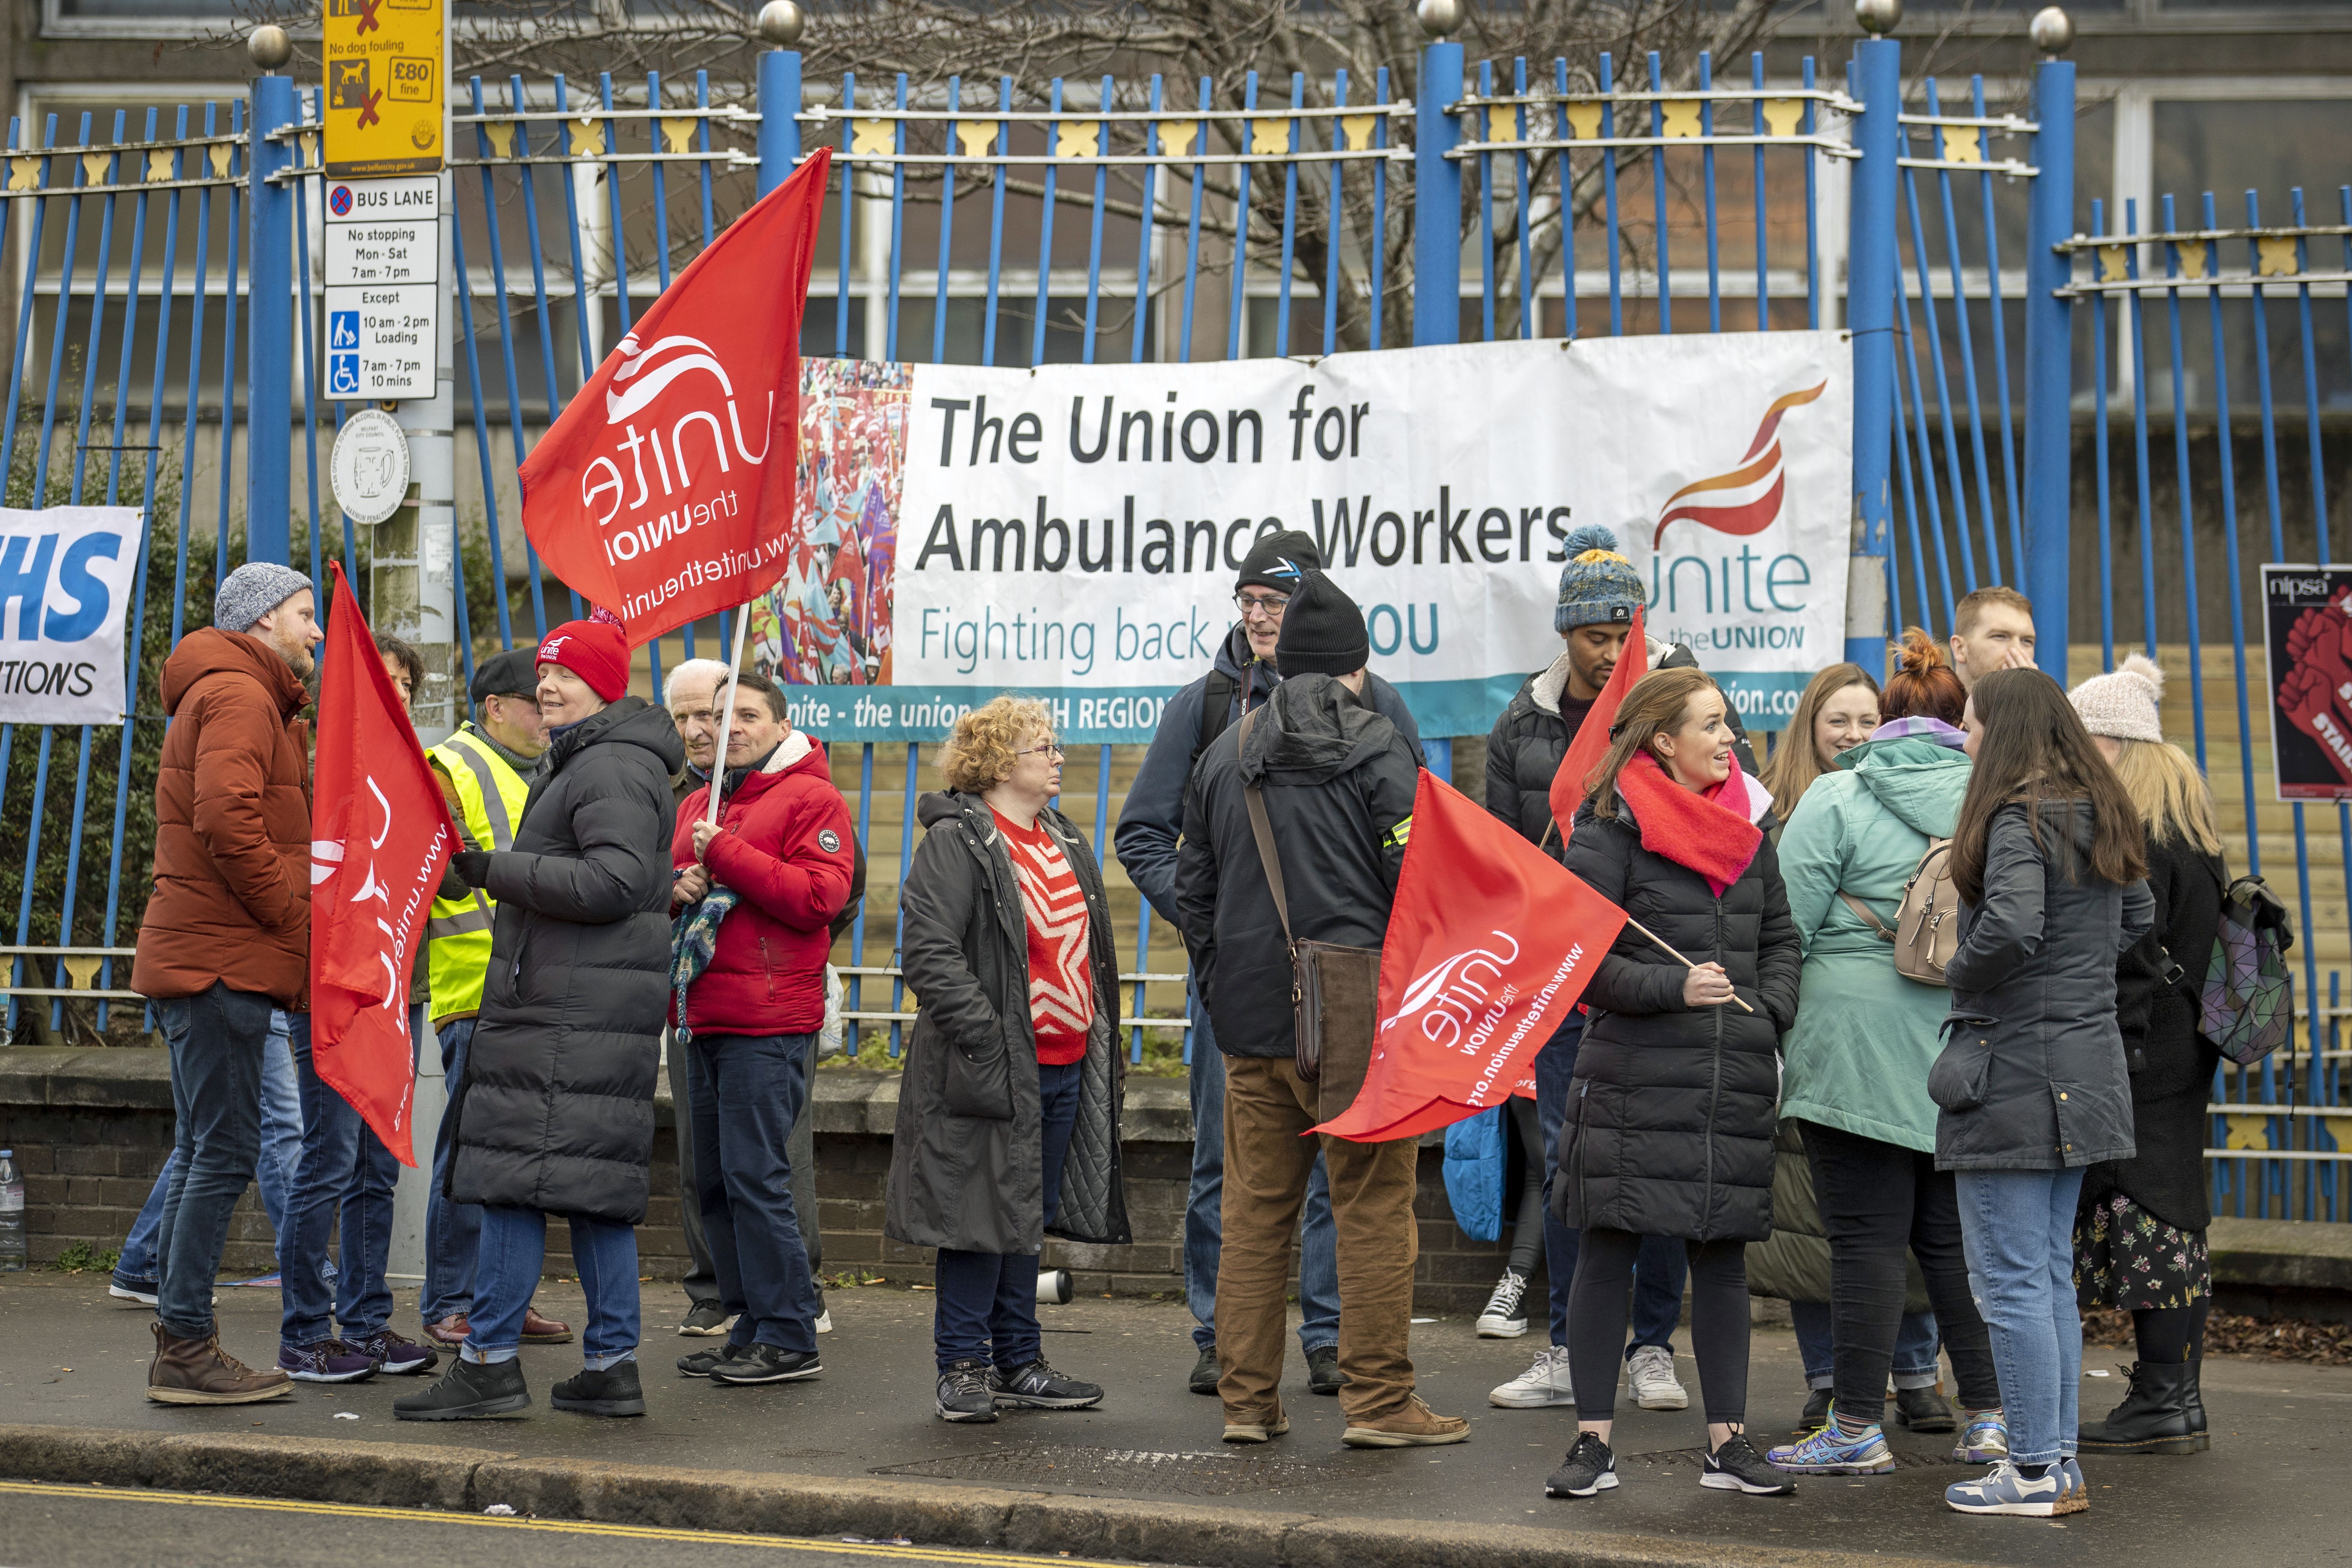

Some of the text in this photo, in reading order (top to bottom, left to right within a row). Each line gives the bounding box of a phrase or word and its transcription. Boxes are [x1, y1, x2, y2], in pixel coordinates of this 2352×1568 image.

[330, 40, 404, 55] No dog fouling
[395, 63, 429, 81] £80
[401, 83, 419, 95] fine
[351, 161, 415, 172] www.belfastcity.gov.uk
[358, 190, 434, 207] BUS LANE
[348, 228, 415, 242] No stopping
[356, 249, 379, 260] Mon
[388, 247, 407, 259] Sat
[362, 292, 400, 305] Except
[375, 332, 418, 344] Loading
[371, 375, 412, 387] 10 mins
[355, 412, 376, 423] ALCOHOL
[376, 412, 381, 421] IN
[381, 416, 396, 431] PUBLIC
[343, 421, 355, 436] DRINK
[931, 384, 1370, 467] The Union for
[338, 435, 344, 444] TO
[395, 429, 407, 452] PLACES
[332, 445, 341, 473] OFFENCE
[403, 452, 408, 460] IN
[399, 477, 408, 495] AREA
[345, 502, 397, 521] MAXIMUM PENALTY £500
[1311, 485, 1571, 569] Workers
[0, 531, 123, 642] HS
[2270, 575, 2328, 605] nipsa
[921, 602, 1439, 676] Fighting back OU
[541, 645, 559, 655] unite
[0, 661, 97, 697] TIONS
[1723, 680, 1804, 715] ion.co
[785, 695, 830, 727] nite
[854, 694, 893, 728] the
